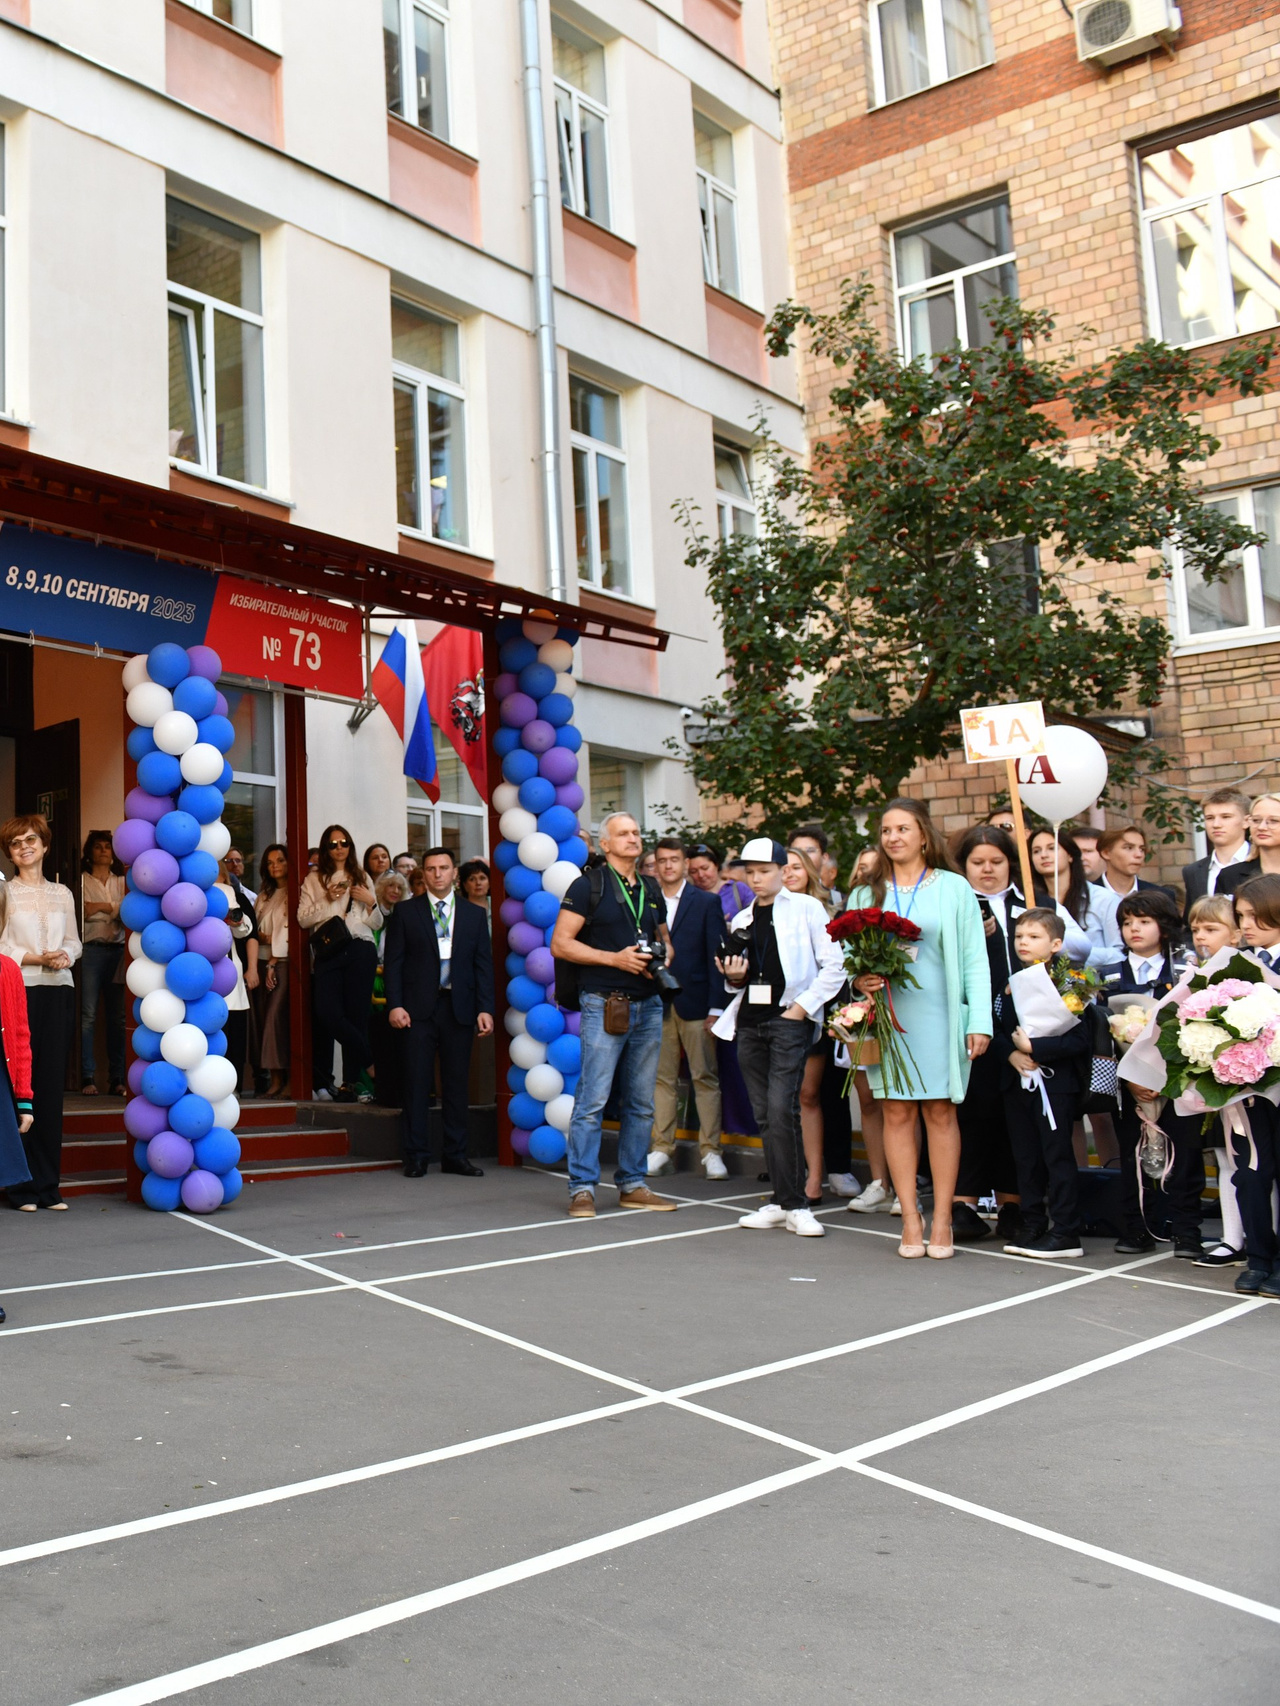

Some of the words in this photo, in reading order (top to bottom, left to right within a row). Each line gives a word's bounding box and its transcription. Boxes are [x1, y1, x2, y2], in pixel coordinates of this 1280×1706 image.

[5, 566, 63, 595] 8,9,10
[65, 578, 150, 613] СЕНТЯБРЯ
[150, 596, 196, 624] 2023
[229, 593, 310, 623] ИЗБИРАТЕЛЬНЫЙ
[309, 612, 349, 633] УЧАСТОК
[262, 635, 282, 661] №
[289, 627, 322, 671] 73
